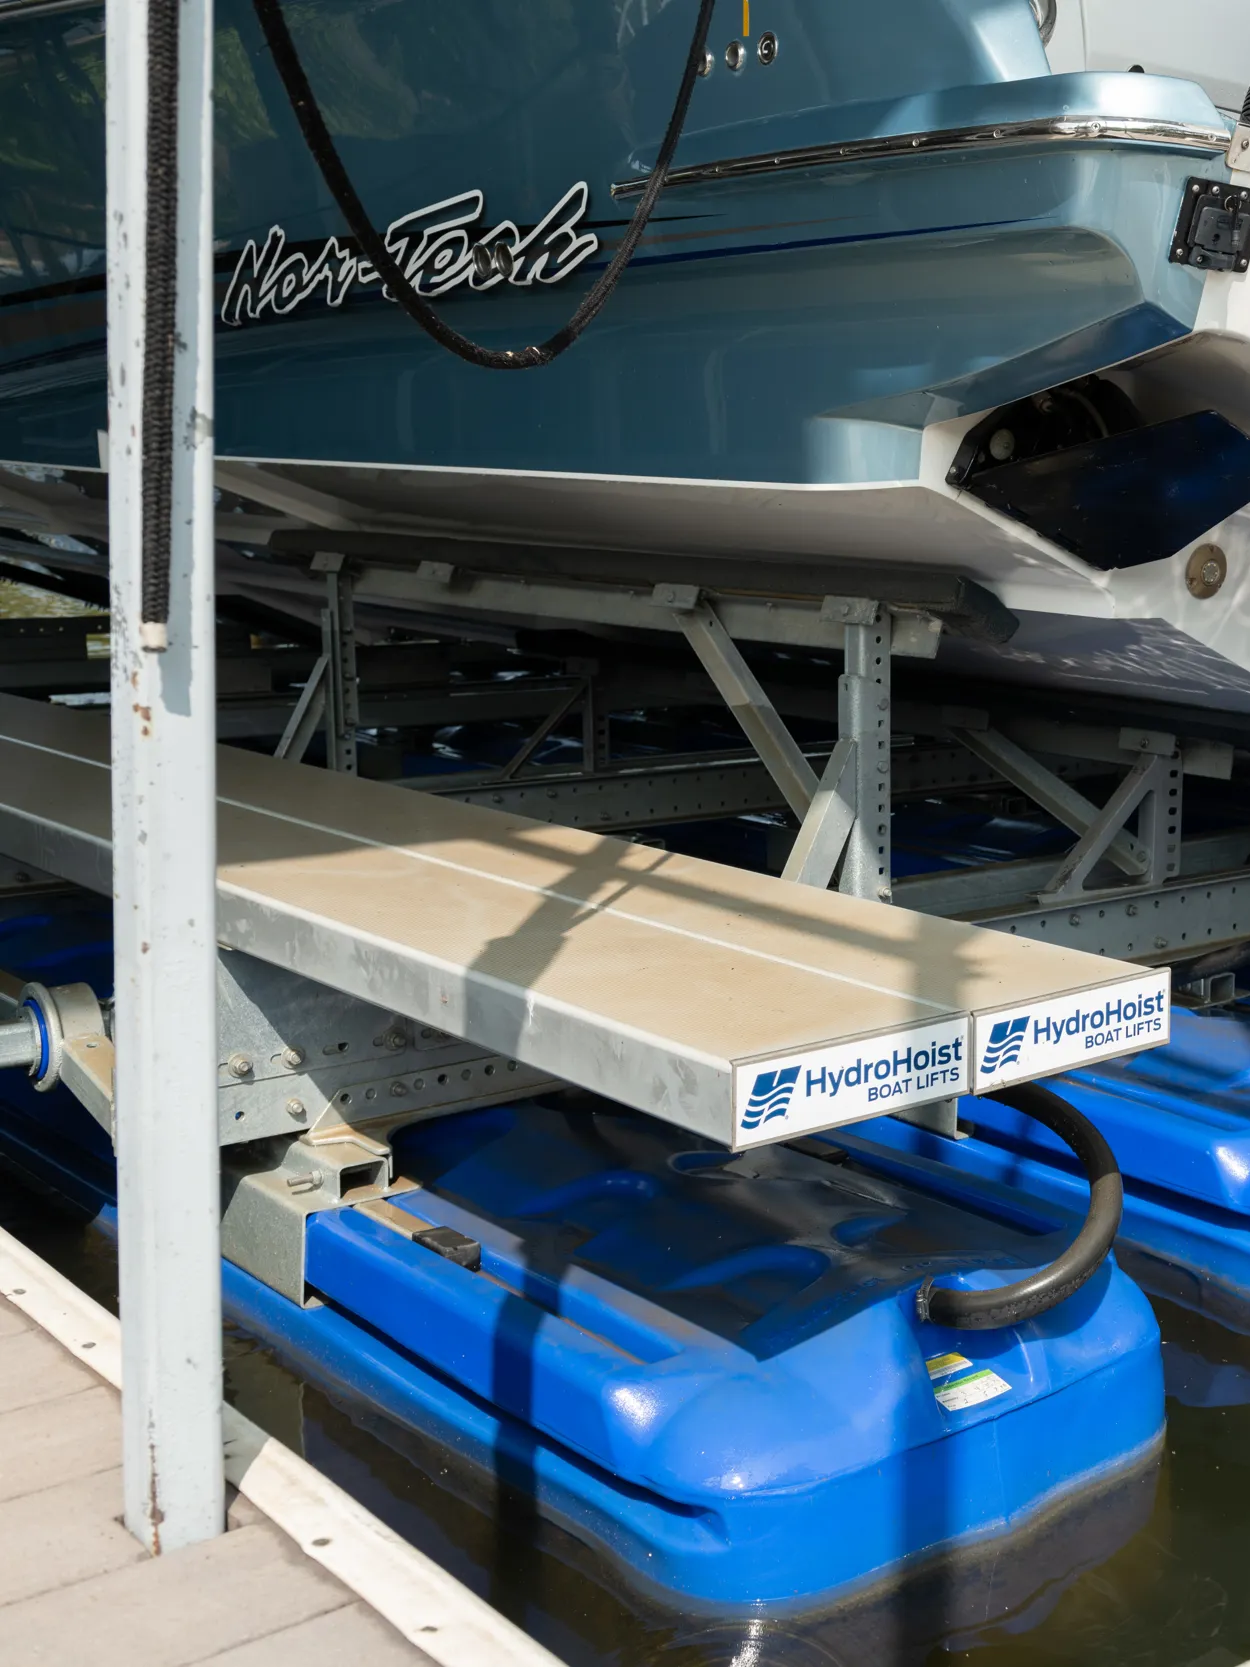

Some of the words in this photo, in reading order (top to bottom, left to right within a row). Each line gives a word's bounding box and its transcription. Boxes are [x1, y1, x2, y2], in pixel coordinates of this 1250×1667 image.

[1033, 990, 1164, 1045] HydroHoist
[1085, 1027, 1122, 1049] BOAT
[1125, 1018, 1162, 1039] LIFTS
[806, 1037, 963, 1097] HydroHoist
[868, 1078, 913, 1102] BOAT
[916, 1067, 960, 1090] LIFTS
